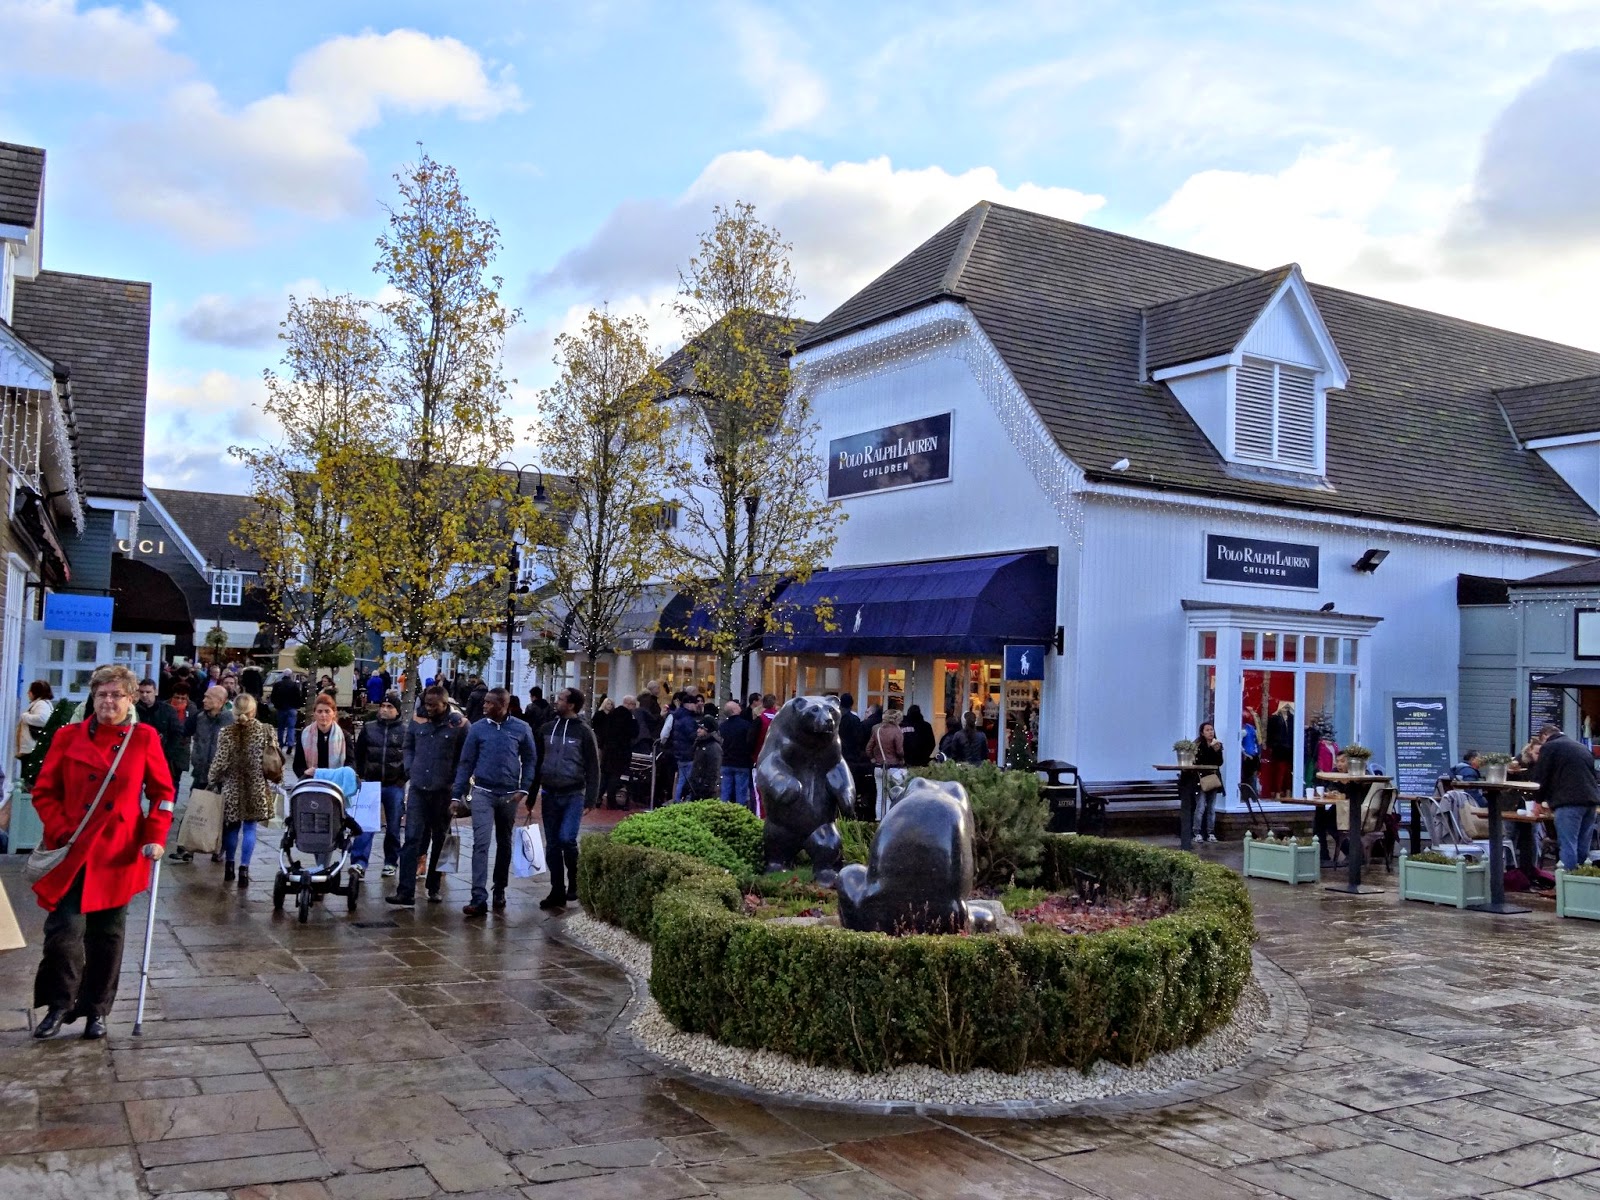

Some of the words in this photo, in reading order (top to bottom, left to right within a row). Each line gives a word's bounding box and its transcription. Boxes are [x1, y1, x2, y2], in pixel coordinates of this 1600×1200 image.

[838, 451, 863, 470] POLO
[864, 445, 897, 464] RALPH
[897, 436, 938, 457] LAUREN
[862, 462, 909, 479] CHILDREN
[1217, 544, 1243, 561] POLO
[1244, 547, 1275, 565] RALPH
[1276, 550, 1310, 569] LAUREN
[1243, 566, 1286, 576] CHILDREN
[48, 609, 110, 618] SMYTHSON
